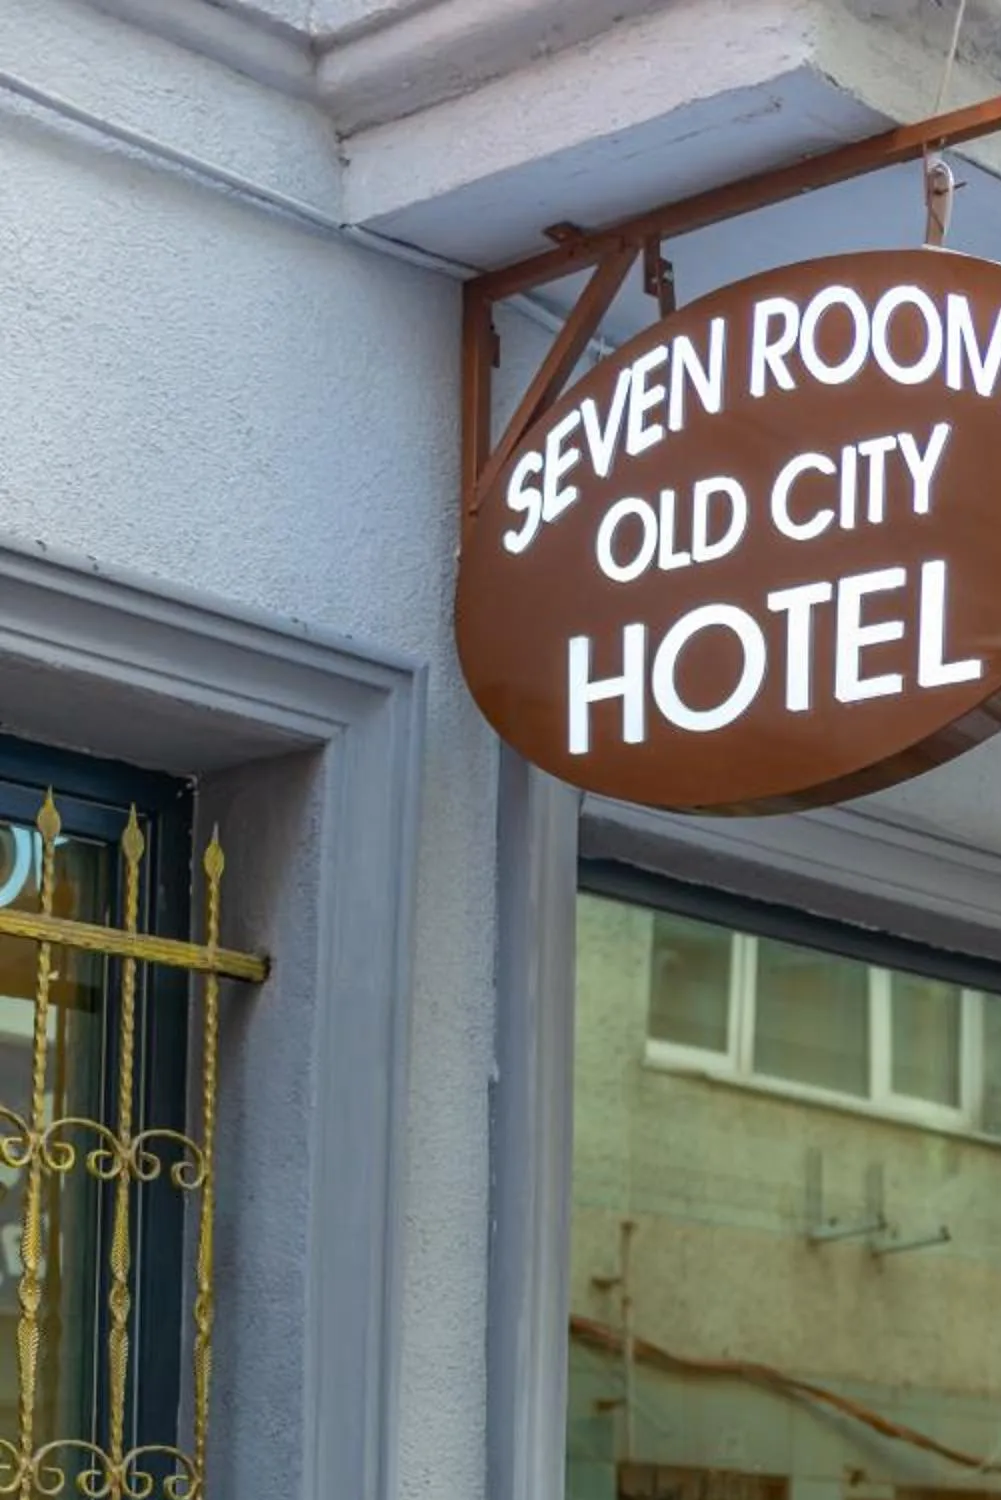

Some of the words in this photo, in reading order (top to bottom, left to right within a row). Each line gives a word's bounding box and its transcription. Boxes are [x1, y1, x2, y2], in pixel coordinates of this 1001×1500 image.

[503, 317, 725, 554] SEVEN
[596, 476, 748, 583] OLD
[770, 422, 951, 541] CITY
[568, 559, 982, 755] HOTEL
